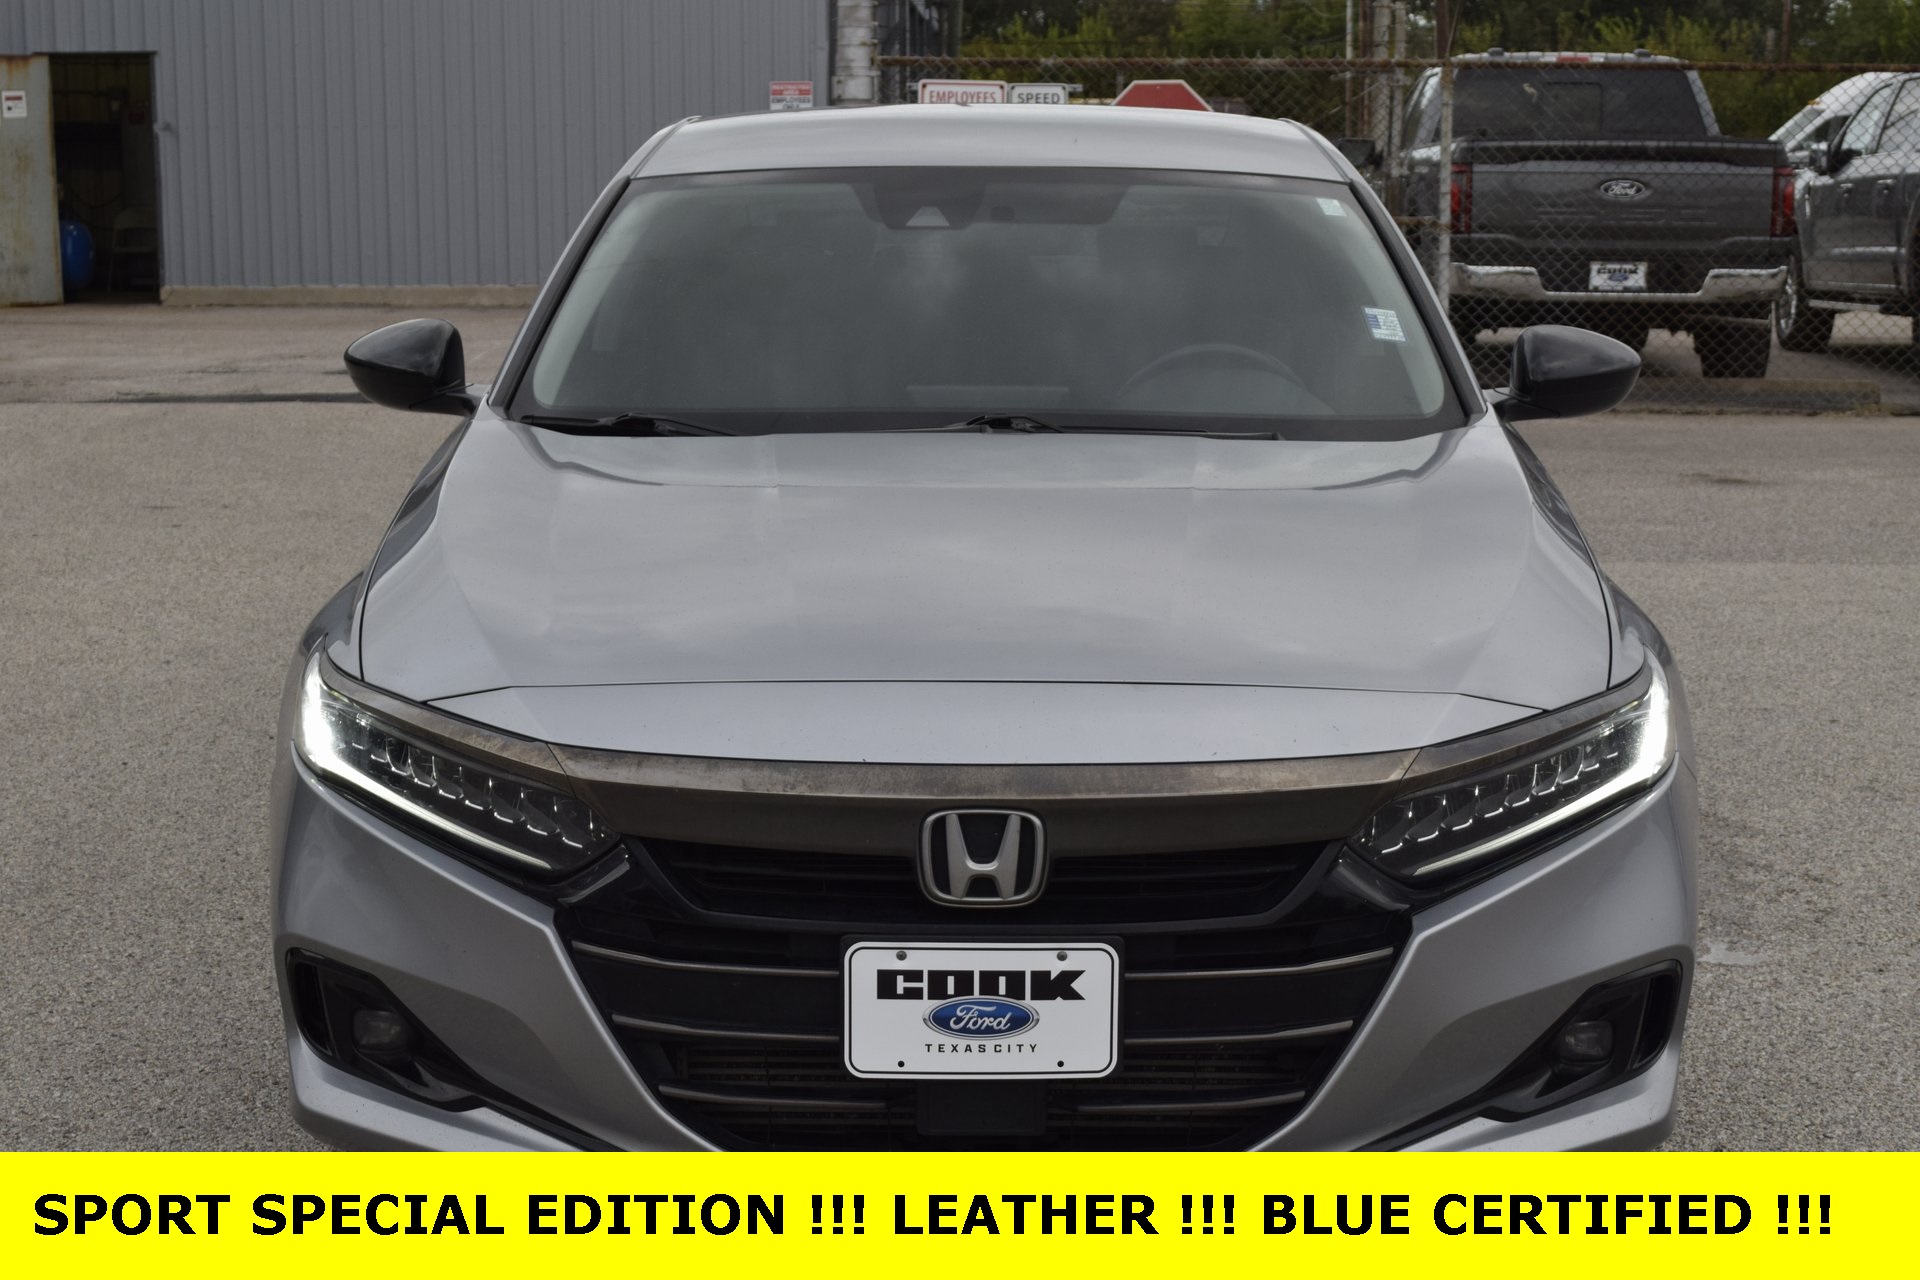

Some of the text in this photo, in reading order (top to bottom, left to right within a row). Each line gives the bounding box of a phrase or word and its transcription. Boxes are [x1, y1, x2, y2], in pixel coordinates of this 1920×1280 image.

[928, 91, 997, 104] EMPLOYEES
[1017, 93, 1060, 104] SPEED
[1608, 182, 1637, 196] Ford
[876, 969, 1087, 1001] COOK
[949, 1004, 1011, 1031] Ford
